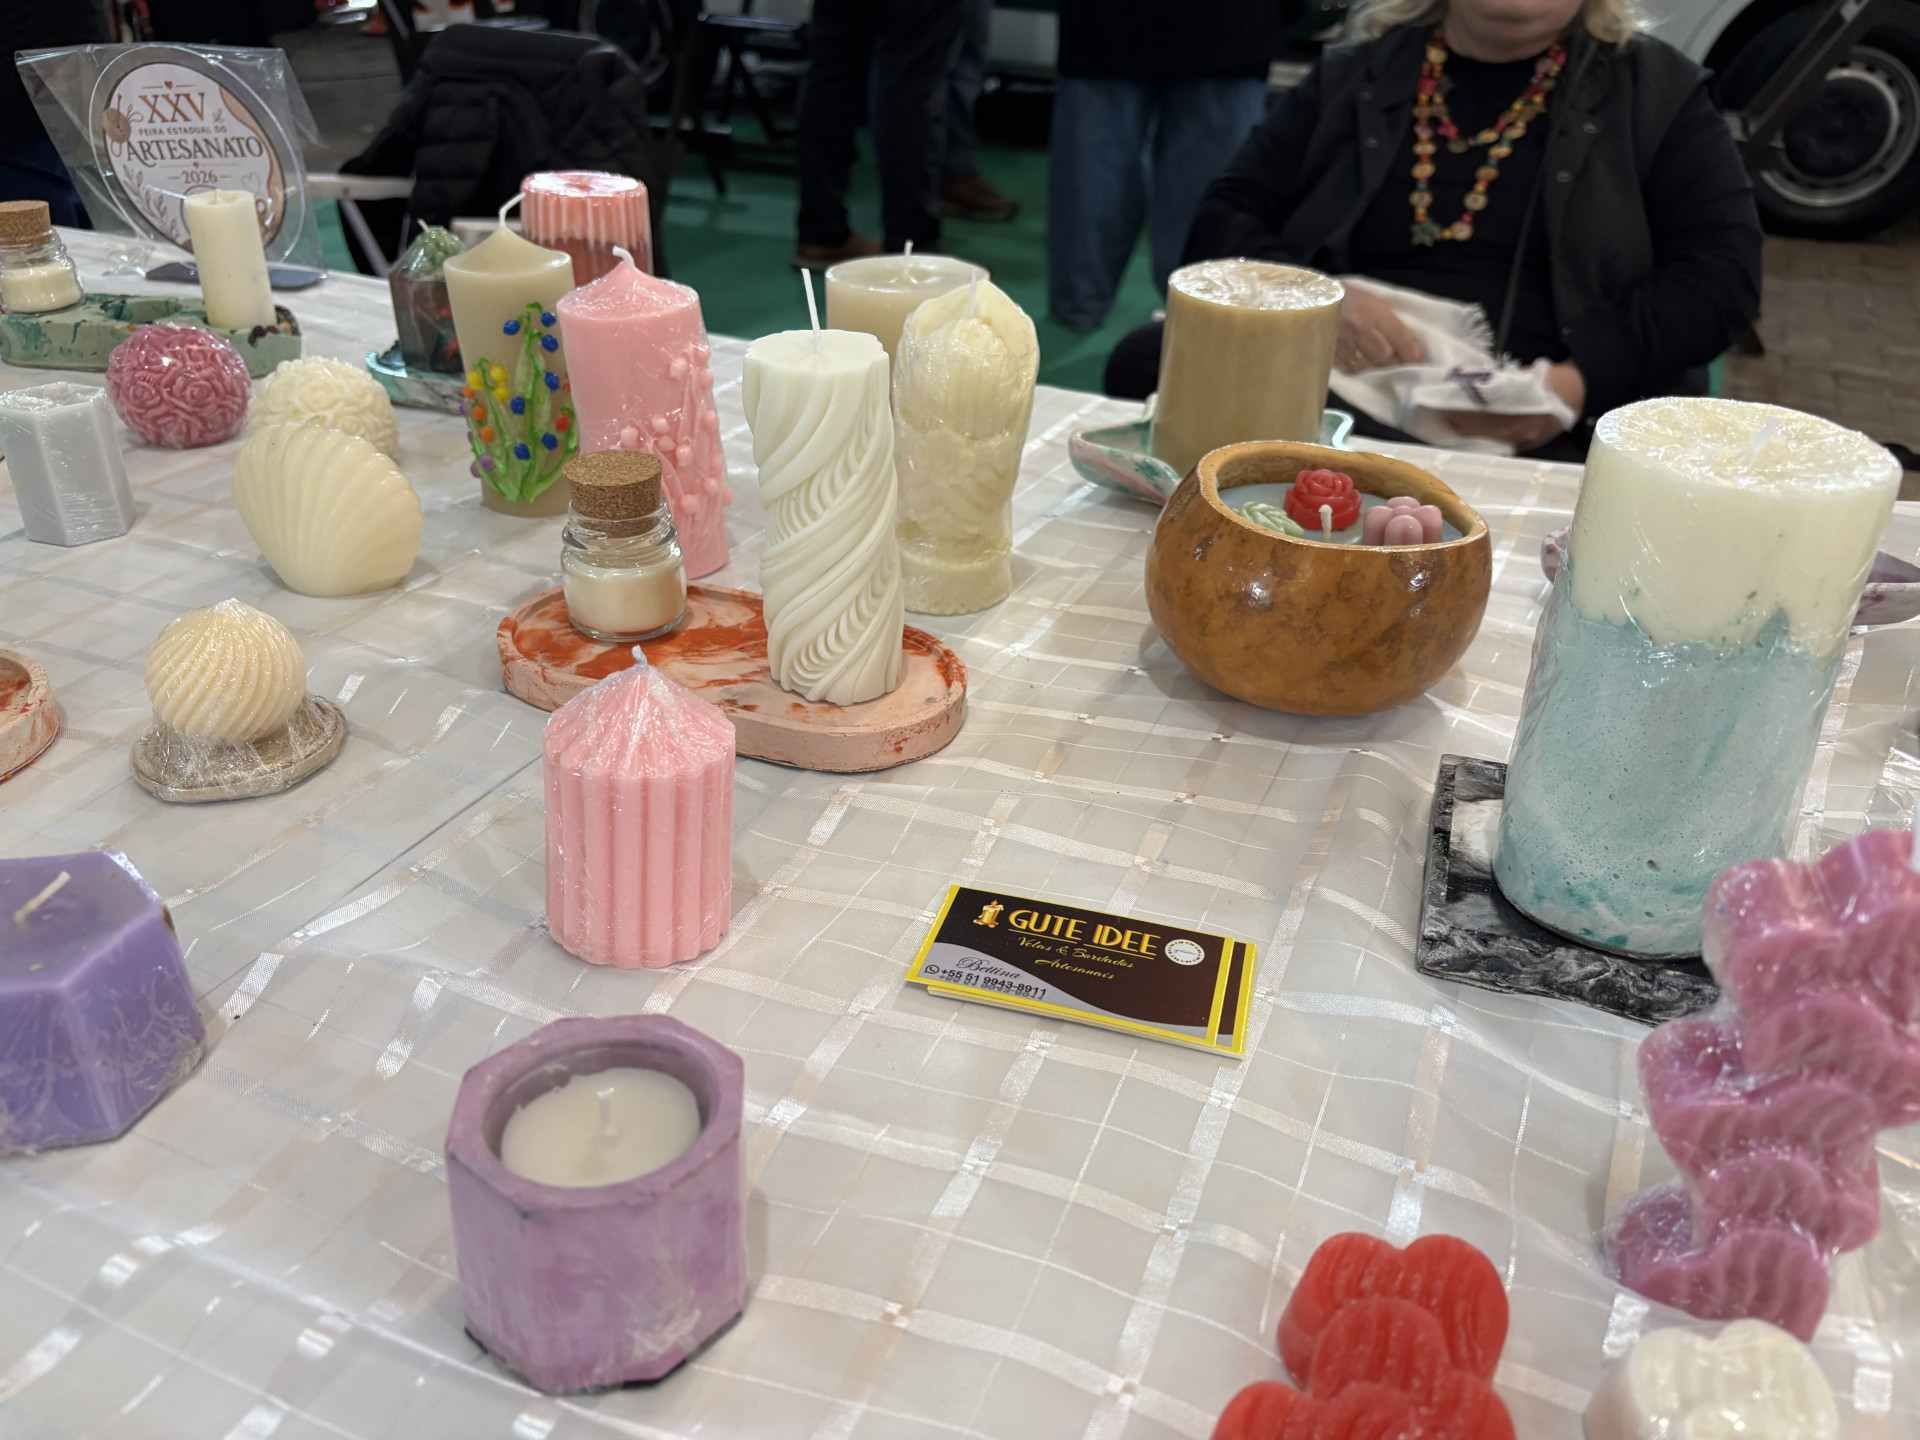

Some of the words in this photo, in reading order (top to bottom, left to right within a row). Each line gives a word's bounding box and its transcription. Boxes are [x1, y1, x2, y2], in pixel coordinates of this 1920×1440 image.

[138, 92, 206, 124] XXV
[138, 127, 165, 136] FEIRA
[167, 126, 212, 136] ESTADUAL
[214, 125, 228, 134] DO
[126, 137, 264, 167] ARTESANATO
[181, 170, 218, 184] 2026
[1008, 909, 1088, 942] GUTE
[1092, 923, 1161, 956] IDEE
[1018, 936, 1053, 952] Velas
[1055, 945, 1069, 957] &
[941, 969, 963, 980] +55
[965, 973, 980, 983] 51
[956, 956, 1022, 979] Bettina
